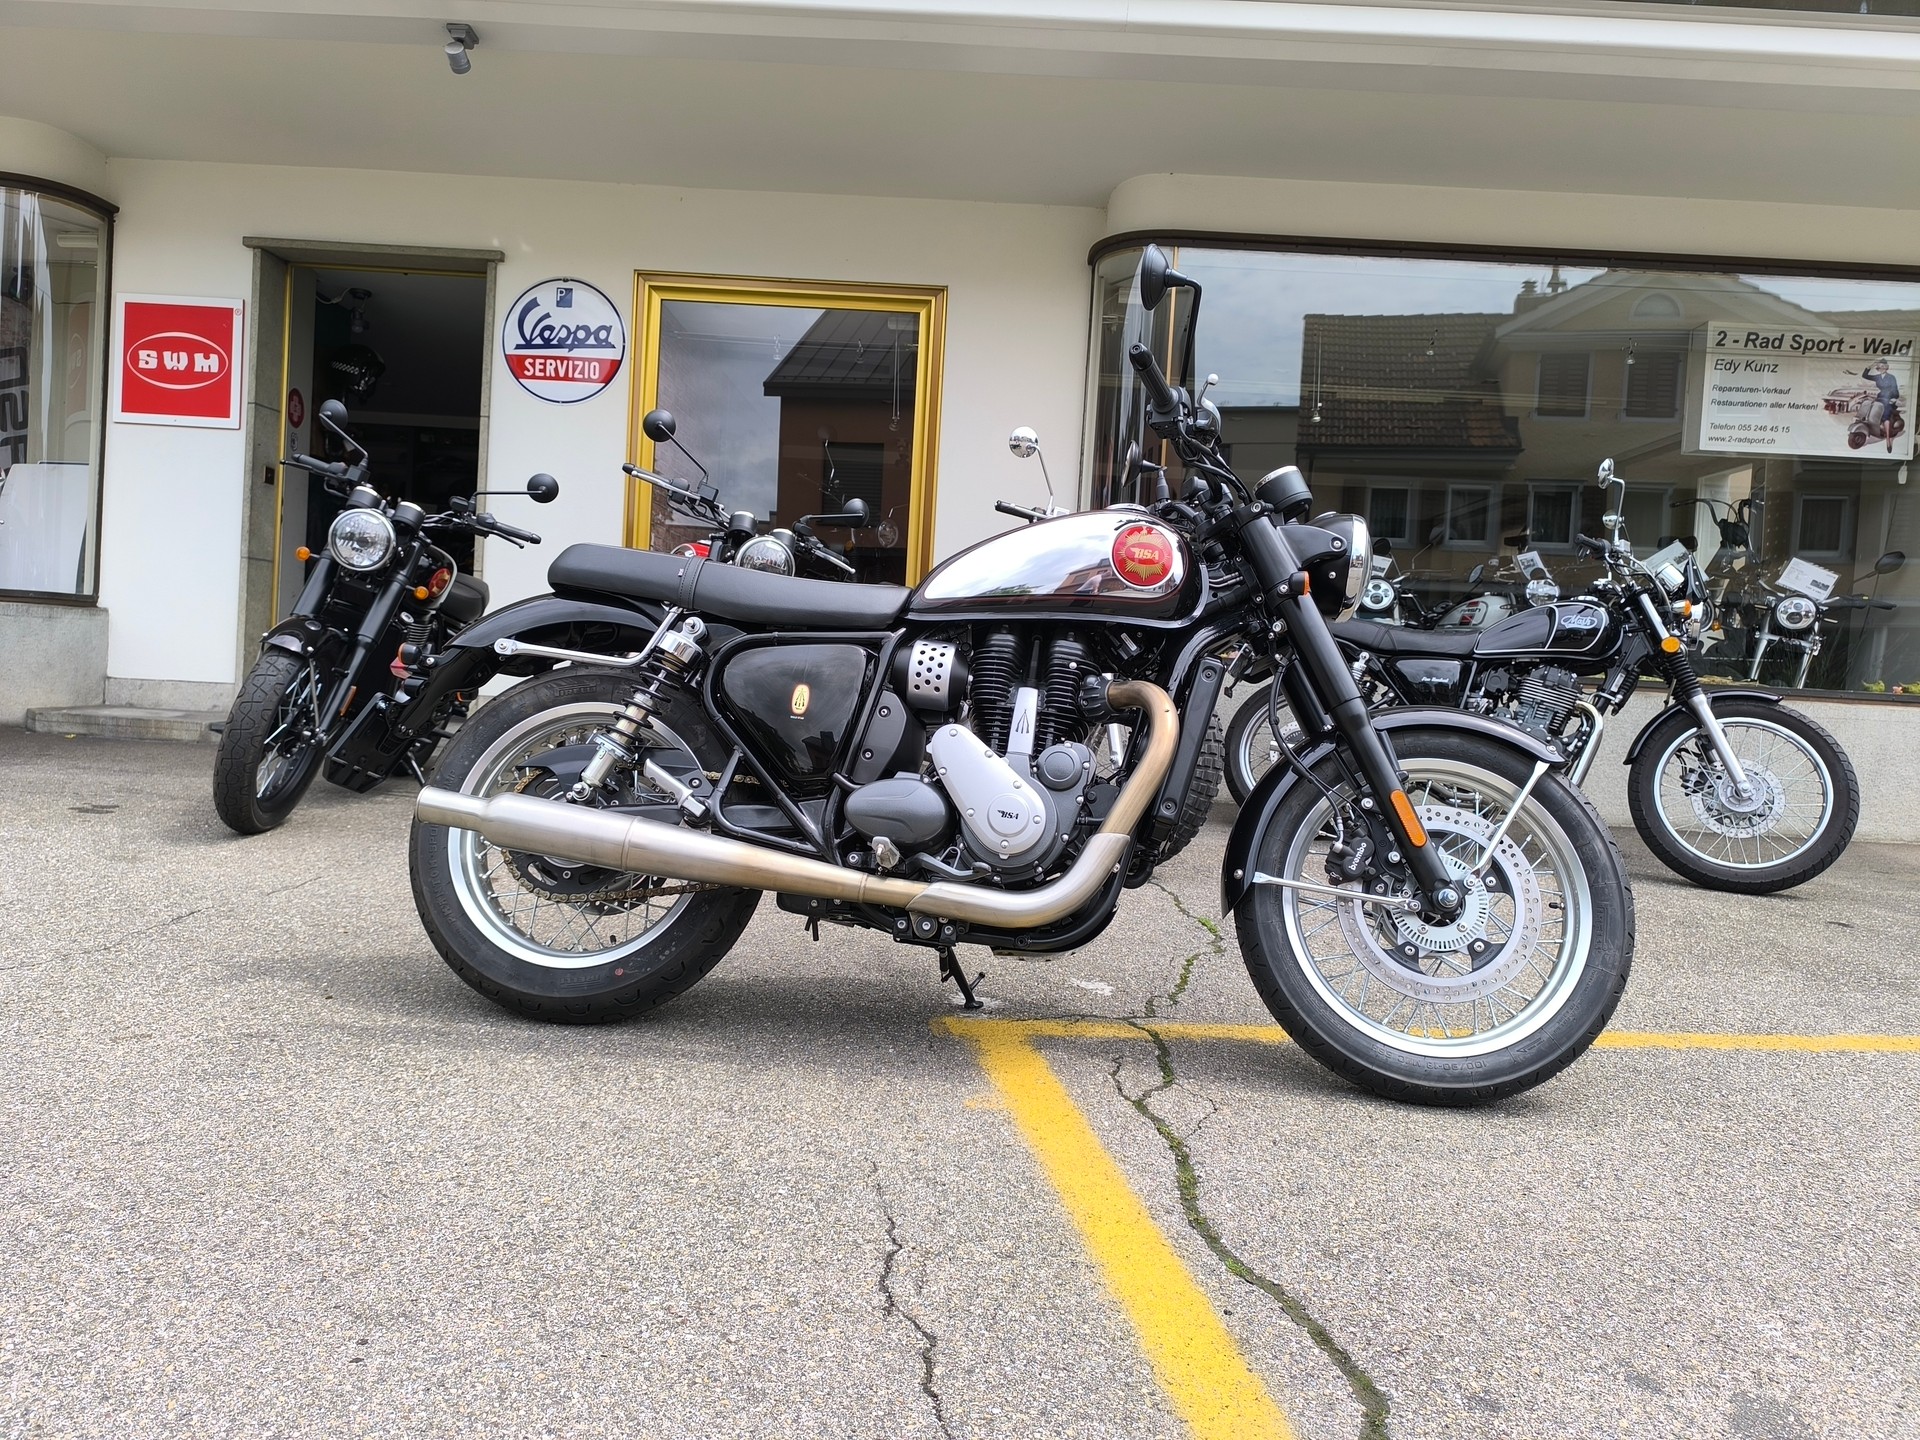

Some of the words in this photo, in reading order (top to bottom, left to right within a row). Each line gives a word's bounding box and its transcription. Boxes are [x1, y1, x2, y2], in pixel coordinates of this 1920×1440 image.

[514, 296, 616, 353] Vespa
[1715, 330, 1728, 347] 2
[1743, 331, 1785, 350] Rad
[1789, 333, 1845, 355] Sport
[1863, 337, 1913, 357] Wald
[138, 350, 219, 373] SWM
[523, 358, 600, 380] SERVIZIO
[1714, 358, 1741, 374] Edy
[1743, 360, 1779, 373] Kunz
[1712, 384, 1791, 395] Reparaturen-Verkauf
[1710, 398, 1768, 408] Restaurationen
[1769, 401, 1786, 409] aller
[1787, 402, 1819, 411] Marken!
[1709, 422, 1736, 431] Telefon
[1737, 423, 1752, 432] 055
[1753, 424, 1768, 432] 246
[1769, 425, 1779, 433] 45
[1708, 435, 1776, 445] www.2-radsport.ch
[1130, 547, 1159, 560] BSA
[1348, 842, 1367, 871] brembo
